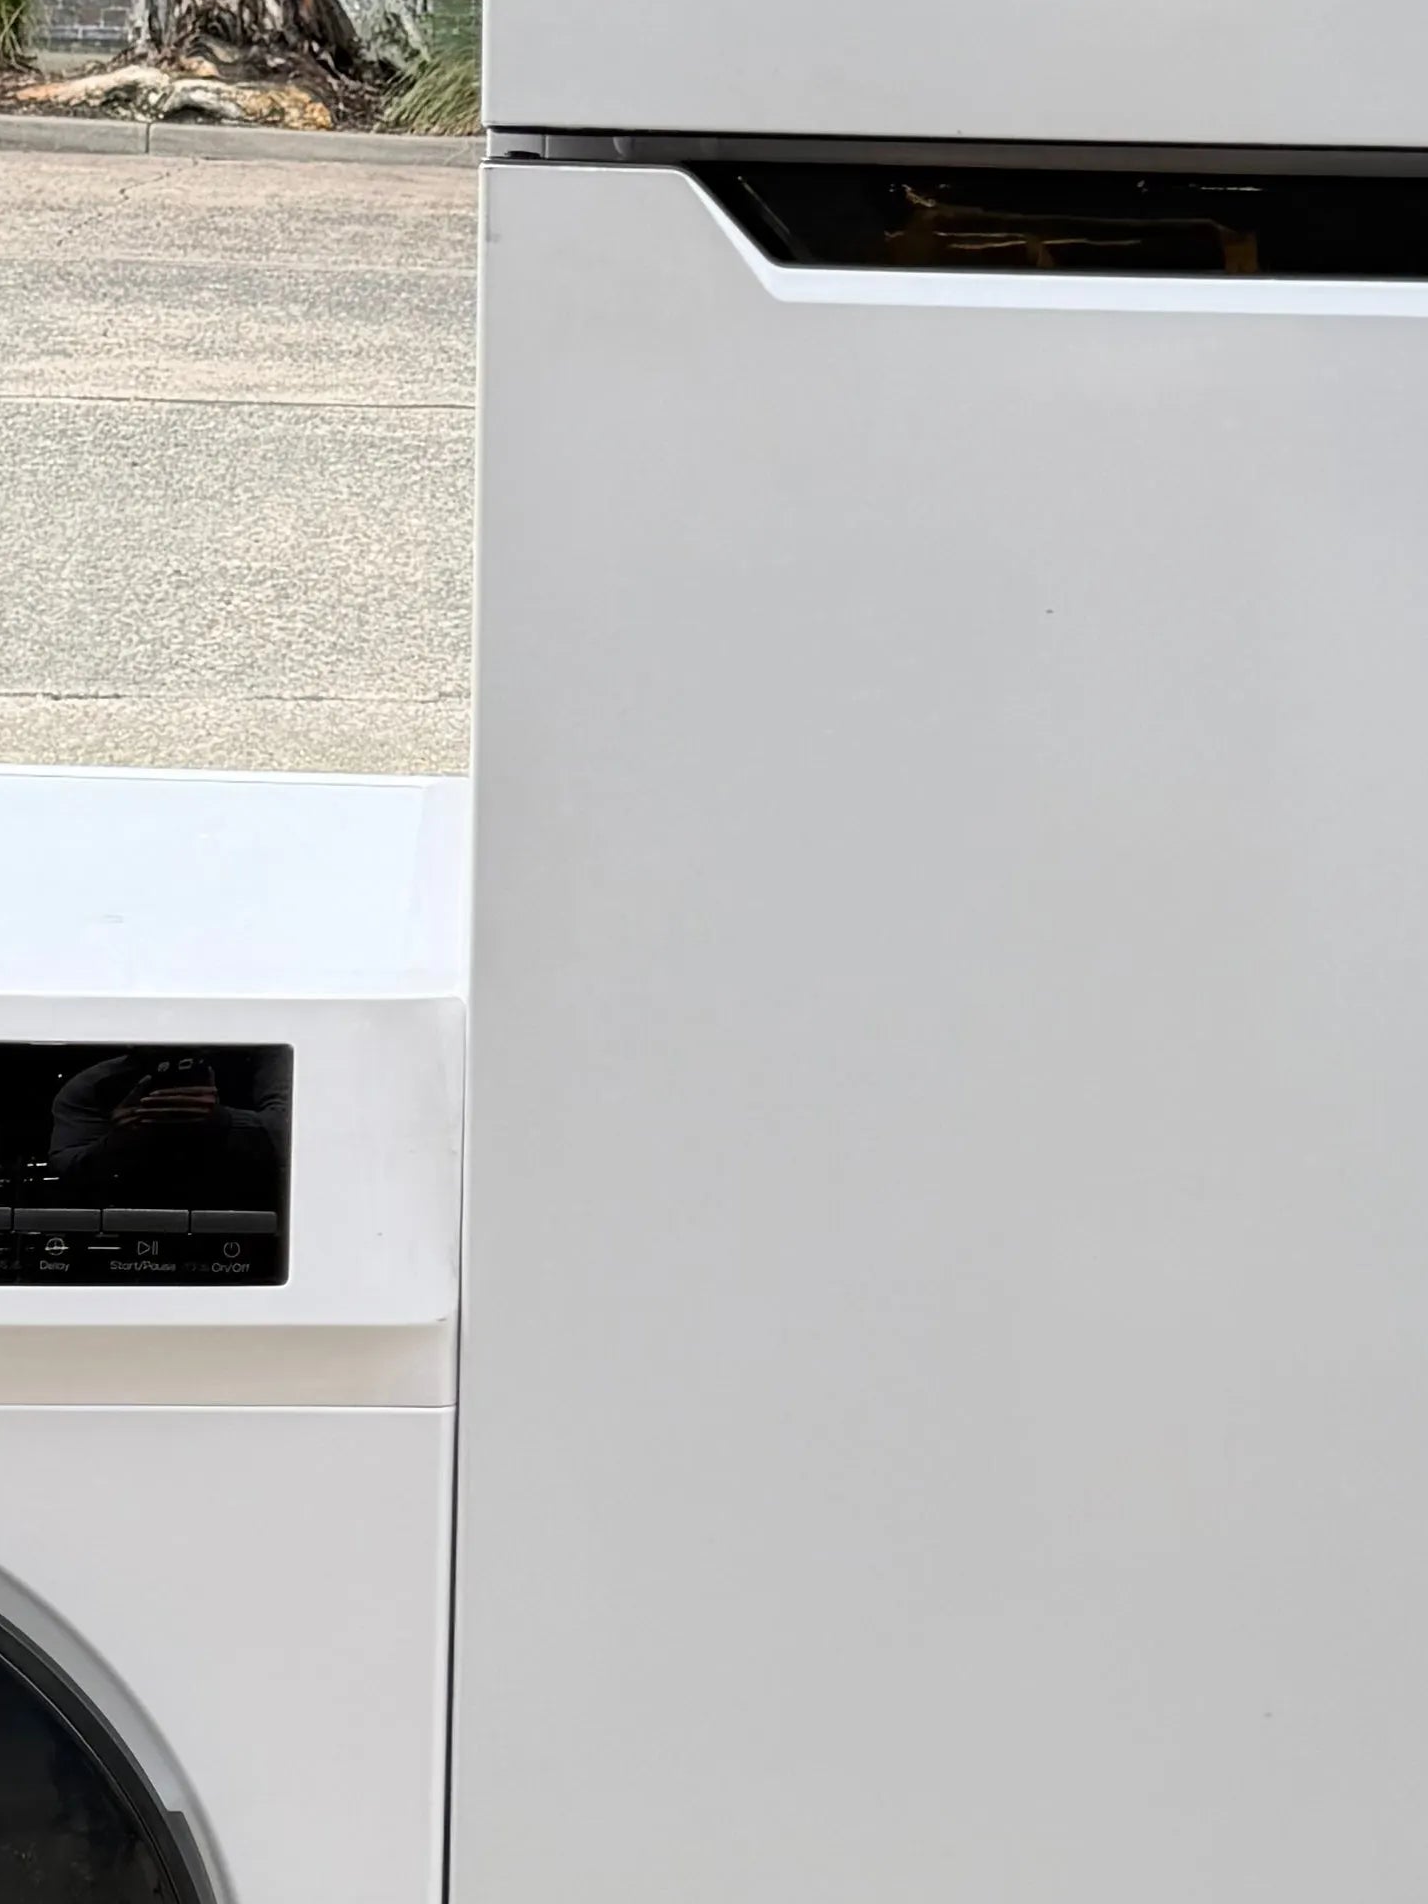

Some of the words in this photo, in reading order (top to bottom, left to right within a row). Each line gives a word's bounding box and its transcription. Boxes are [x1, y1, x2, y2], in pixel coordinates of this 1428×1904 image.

[39, 1259, 71, 1273] Delay
[109, 1259, 178, 1273] Start/Pause
[211, 1261, 251, 1274] On/Off
